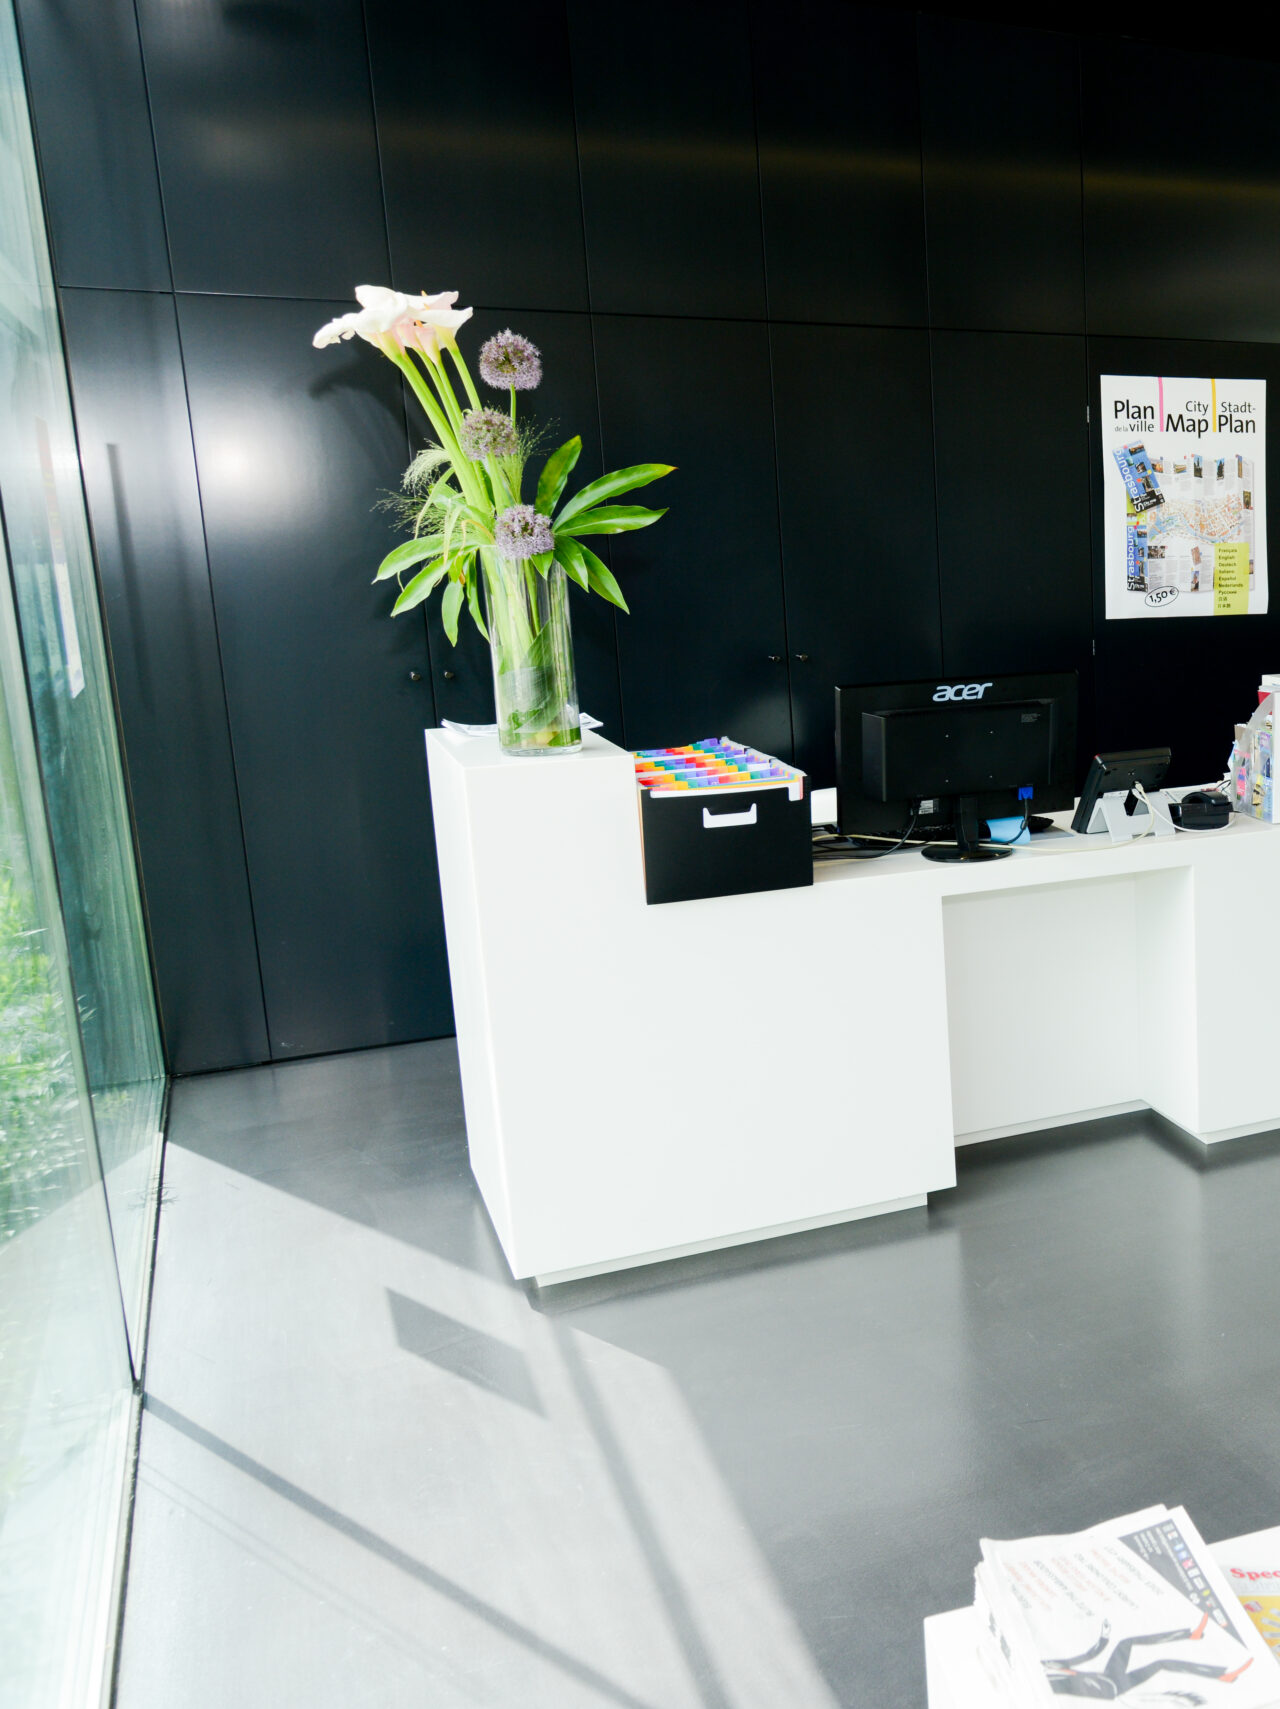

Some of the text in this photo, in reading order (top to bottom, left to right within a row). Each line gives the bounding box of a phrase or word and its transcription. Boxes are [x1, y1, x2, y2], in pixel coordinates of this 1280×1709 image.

[1114, 399, 1155, 420] Plan
[1185, 400, 1209, 415] City
[1221, 401, 1256, 414] Stadt-
[1129, 421, 1155, 432] ville
[1166, 413, 1209, 439] Map
[1218, 414, 1256, 433] Plan
[1113, 449, 1145, 512] Strasbourg
[1127, 526, 1135, 590] Strasbourg
[1149, 587, 1177, 603] 1,50 €
[932, 682, 993, 702] acer
